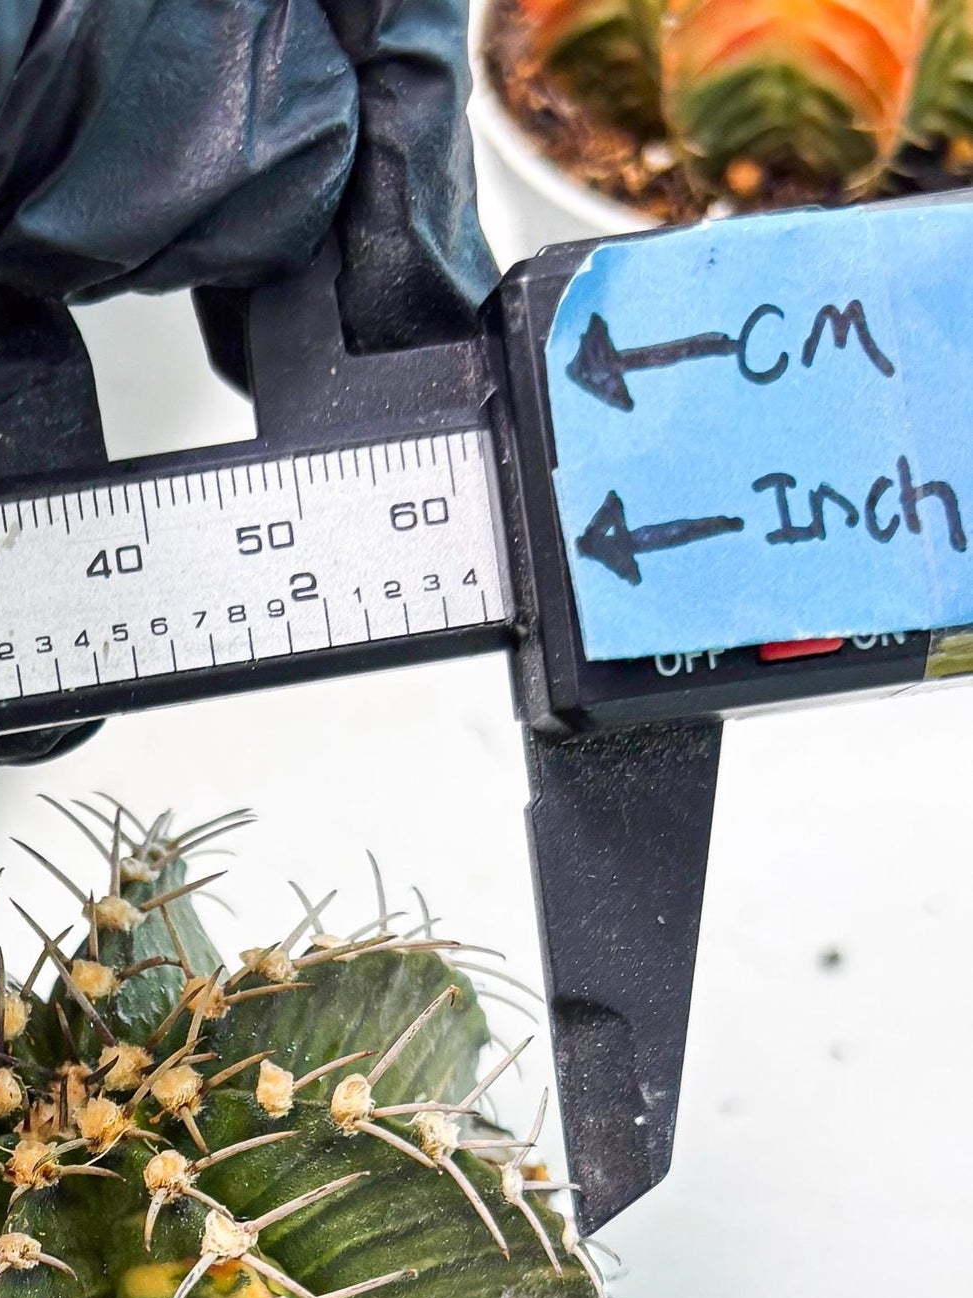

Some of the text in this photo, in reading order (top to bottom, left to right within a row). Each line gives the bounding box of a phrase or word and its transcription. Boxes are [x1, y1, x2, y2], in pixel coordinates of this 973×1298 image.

[87, 545, 142, 578] 40
[236, 521, 294, 555] 50
[390, 497, 449, 531] 60
[752, 455, 967, 552] Inch
[36, 636, 52, 653] 3
[75, 630, 90, 648] 4
[112, 623, 128, 641] 5
[151, 617, 168, 635] 6
[193, 611, 206, 628] 7
[228, 605, 246, 623] 8
[267, 599, 285, 617] 9
[290, 572, 318, 601] 2
[354, 587, 361, 603] 1
[384, 581, 401, 599] 2
[423, 574, 440, 591] 3
[463, 568, 477, 585] 4
